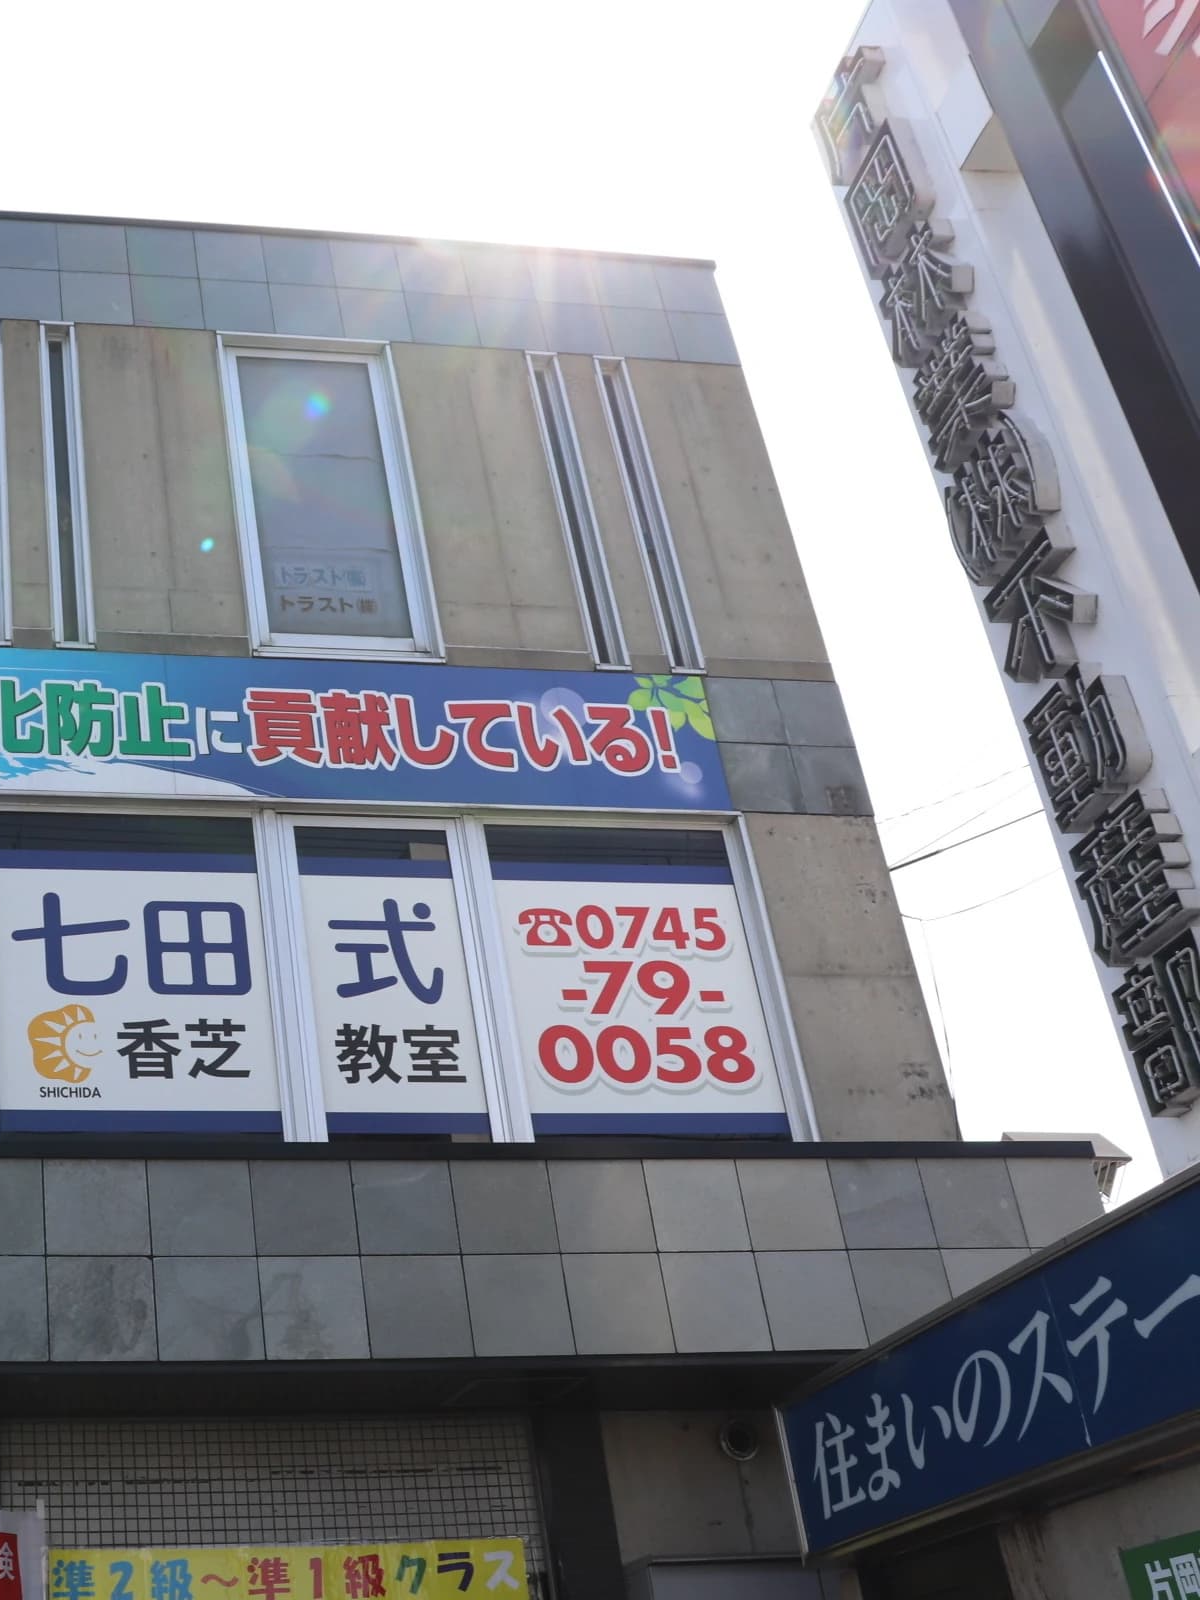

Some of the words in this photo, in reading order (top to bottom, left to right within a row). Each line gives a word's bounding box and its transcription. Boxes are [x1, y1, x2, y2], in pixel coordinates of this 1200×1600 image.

[575, 904, 727, 952] 0745
[538, 1024, 756, 1084] 0058
[39, 1086, 102, 1099] SHICHIDA
[1144, 1552, 1200, 1600] 片岡
